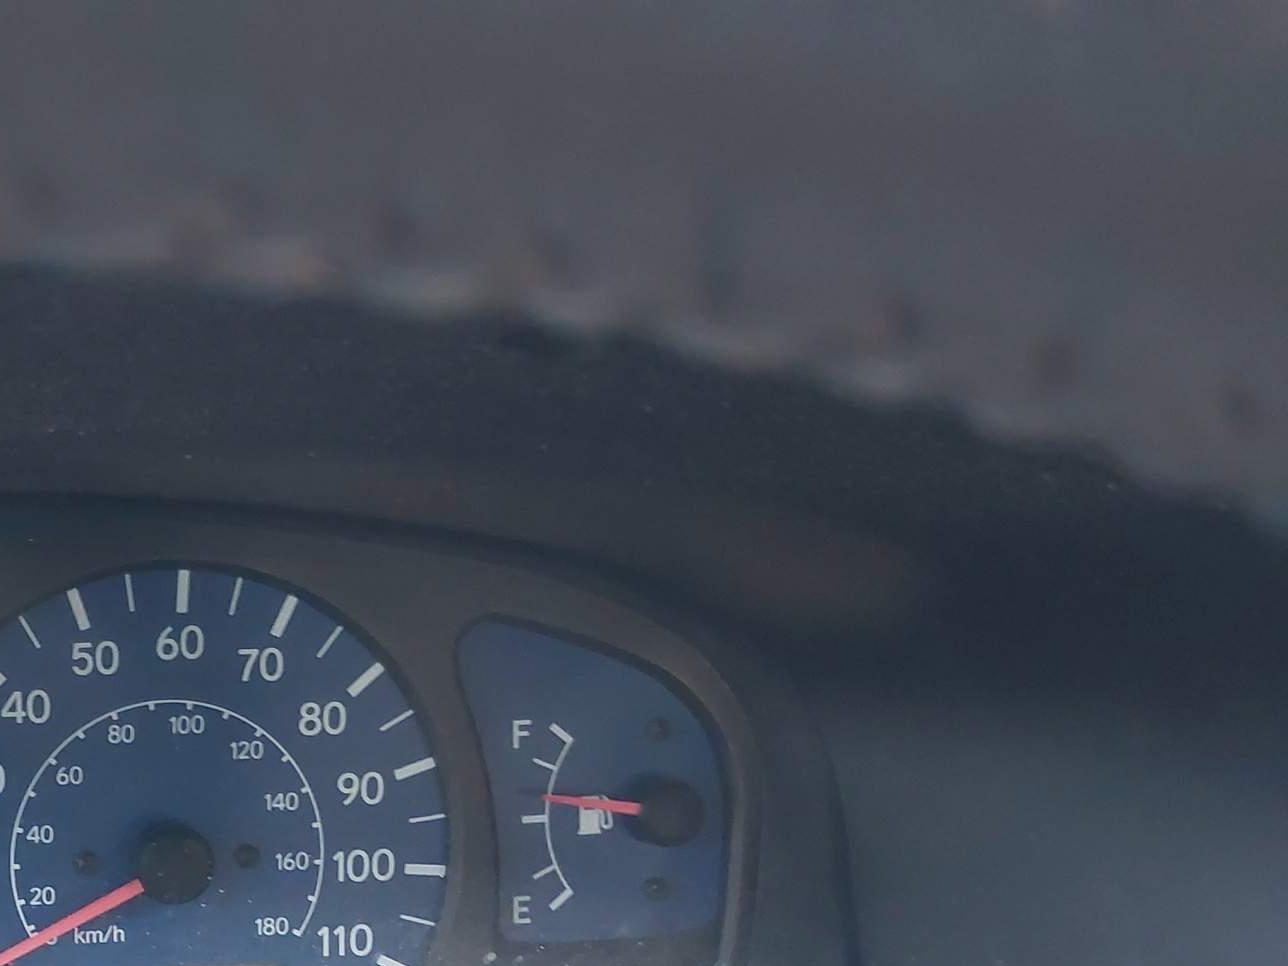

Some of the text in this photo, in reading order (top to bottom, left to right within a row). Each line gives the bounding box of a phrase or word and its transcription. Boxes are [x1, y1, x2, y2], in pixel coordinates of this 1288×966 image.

[156, 624, 205, 661] 60
[71, 640, 120, 676] 50
[237, 647, 285, 682] 70
[0, 688, 51, 725] 40
[298, 701, 347, 737] 80
[107, 723, 135, 745] 80
[169, 714, 205, 736] 100
[513, 720, 532, 749] F
[229, 740, 264, 761] 120
[55, 764, 83, 787] 60
[336, 770, 384, 806] 90
[263, 791, 299, 813] 140
[26, 824, 54, 845] 40
[274, 850, 310, 872] 160
[332, 847, 395, 883] 100
[29, 885, 56, 907] 20
[513, 896, 531, 924] E
[73, 924, 126, 946] km/h
[254, 916, 289, 937] 180
[316, 923, 373, 958] 110
